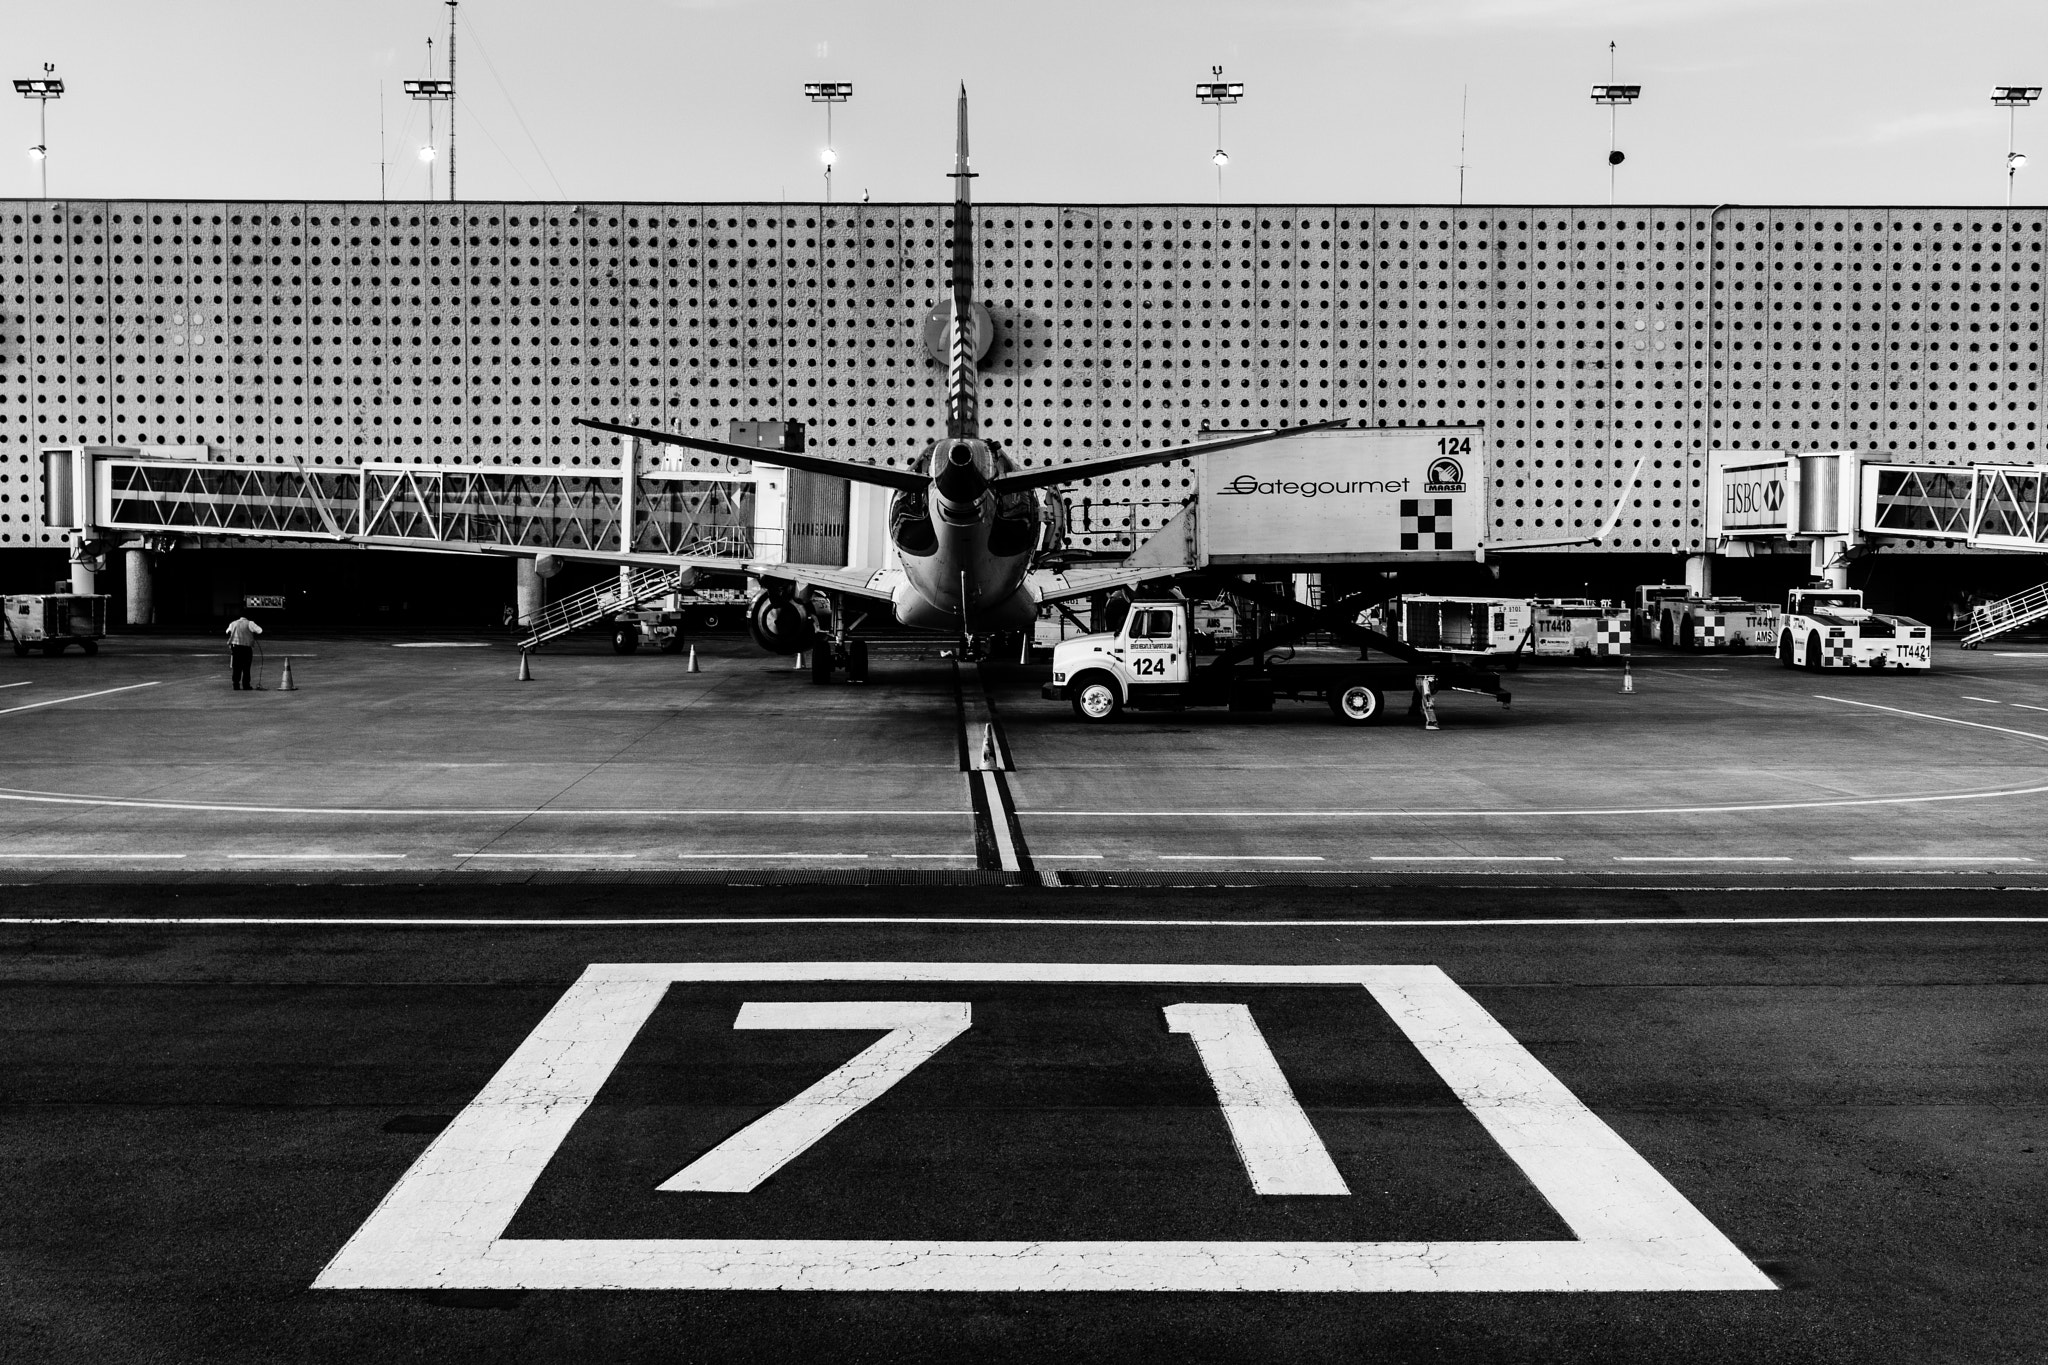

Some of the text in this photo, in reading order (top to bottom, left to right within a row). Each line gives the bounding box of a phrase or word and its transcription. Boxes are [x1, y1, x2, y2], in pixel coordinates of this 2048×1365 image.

[1437, 437, 1472, 455] 124
[1217, 475, 1411, 498] Gategourmet
[1428, 484, 1463, 492] MAASA
[1726, 482, 1762, 514] HSBC
[1538, 619, 1571, 632] TT4418
[1756, 630, 1774, 642] AMS
[1896, 644, 1930, 658] TT4421
[1133, 658, 1166, 676] 124
[655, 1001, 1352, 1196] 71
